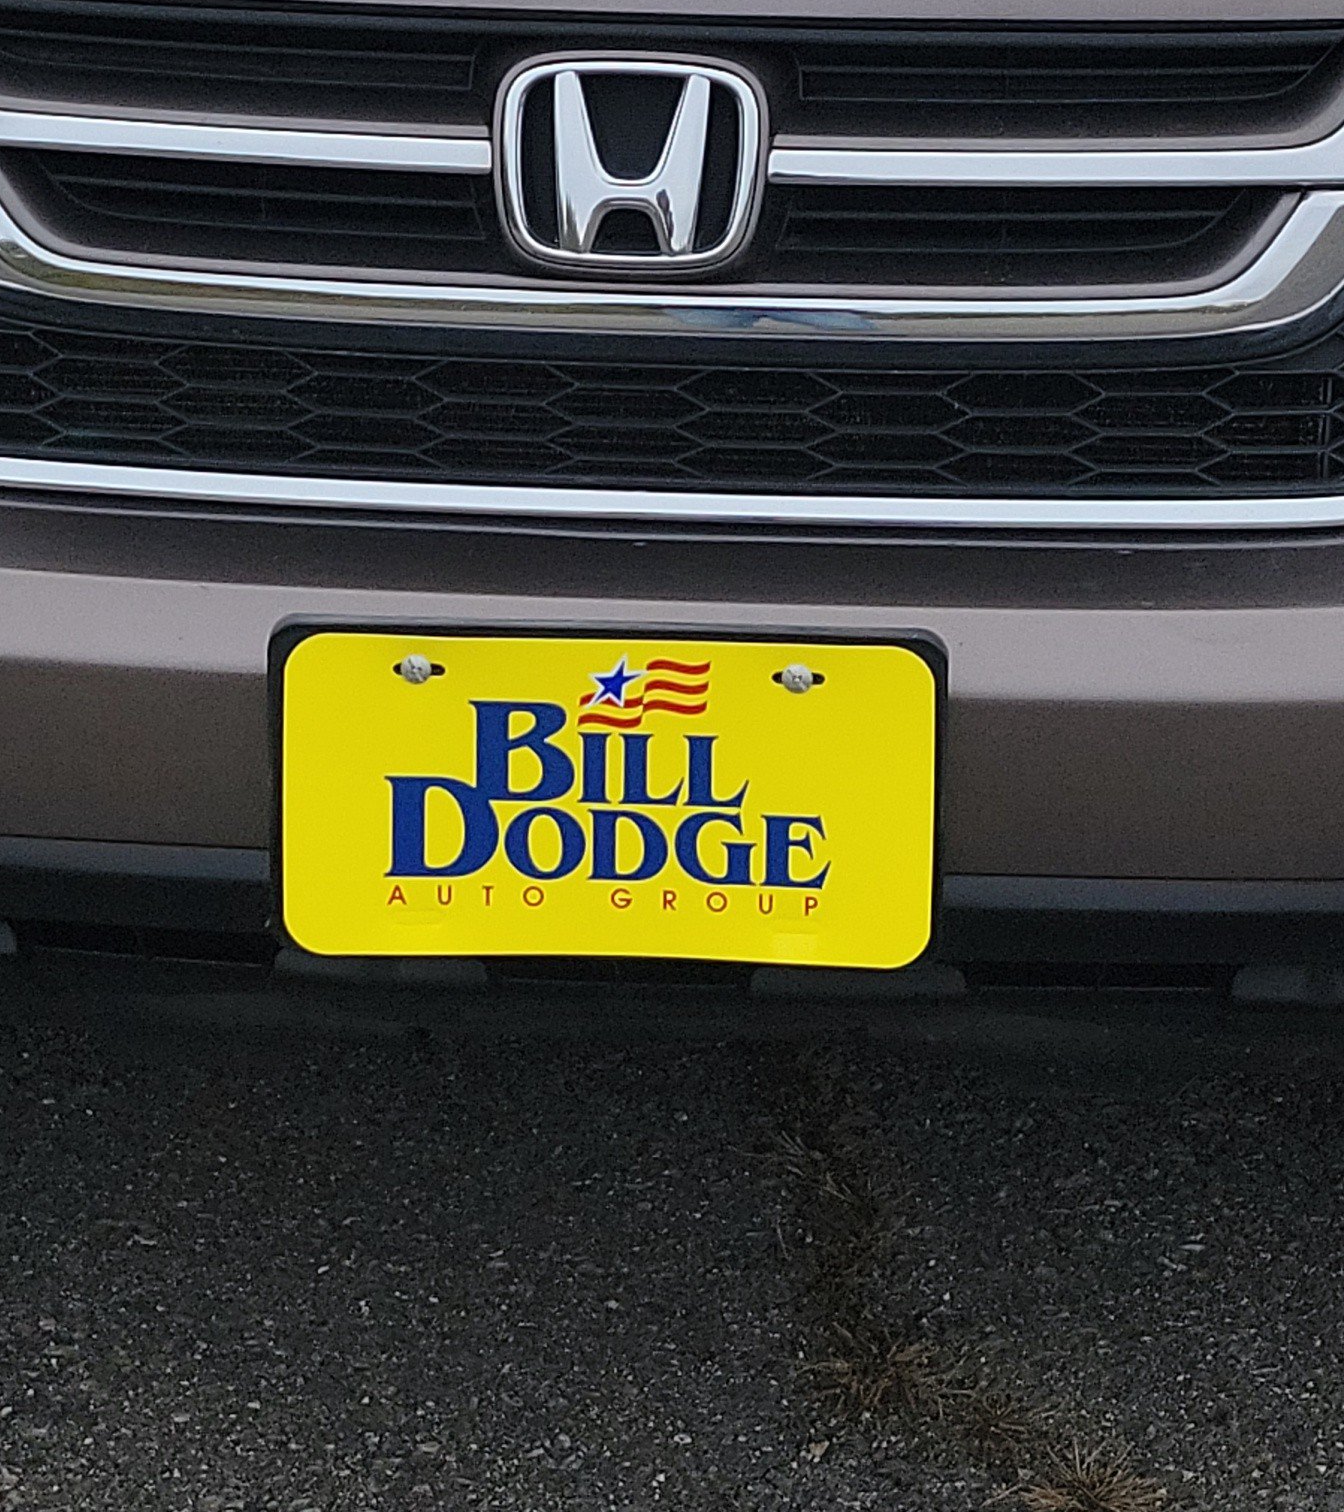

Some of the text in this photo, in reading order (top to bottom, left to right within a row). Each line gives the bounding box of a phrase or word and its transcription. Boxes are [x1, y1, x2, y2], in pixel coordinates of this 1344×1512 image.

[468, 699, 750, 808] BILL
[383, 775, 832, 890] DODGE
[387, 884, 820, 917] AUTO GROUP
